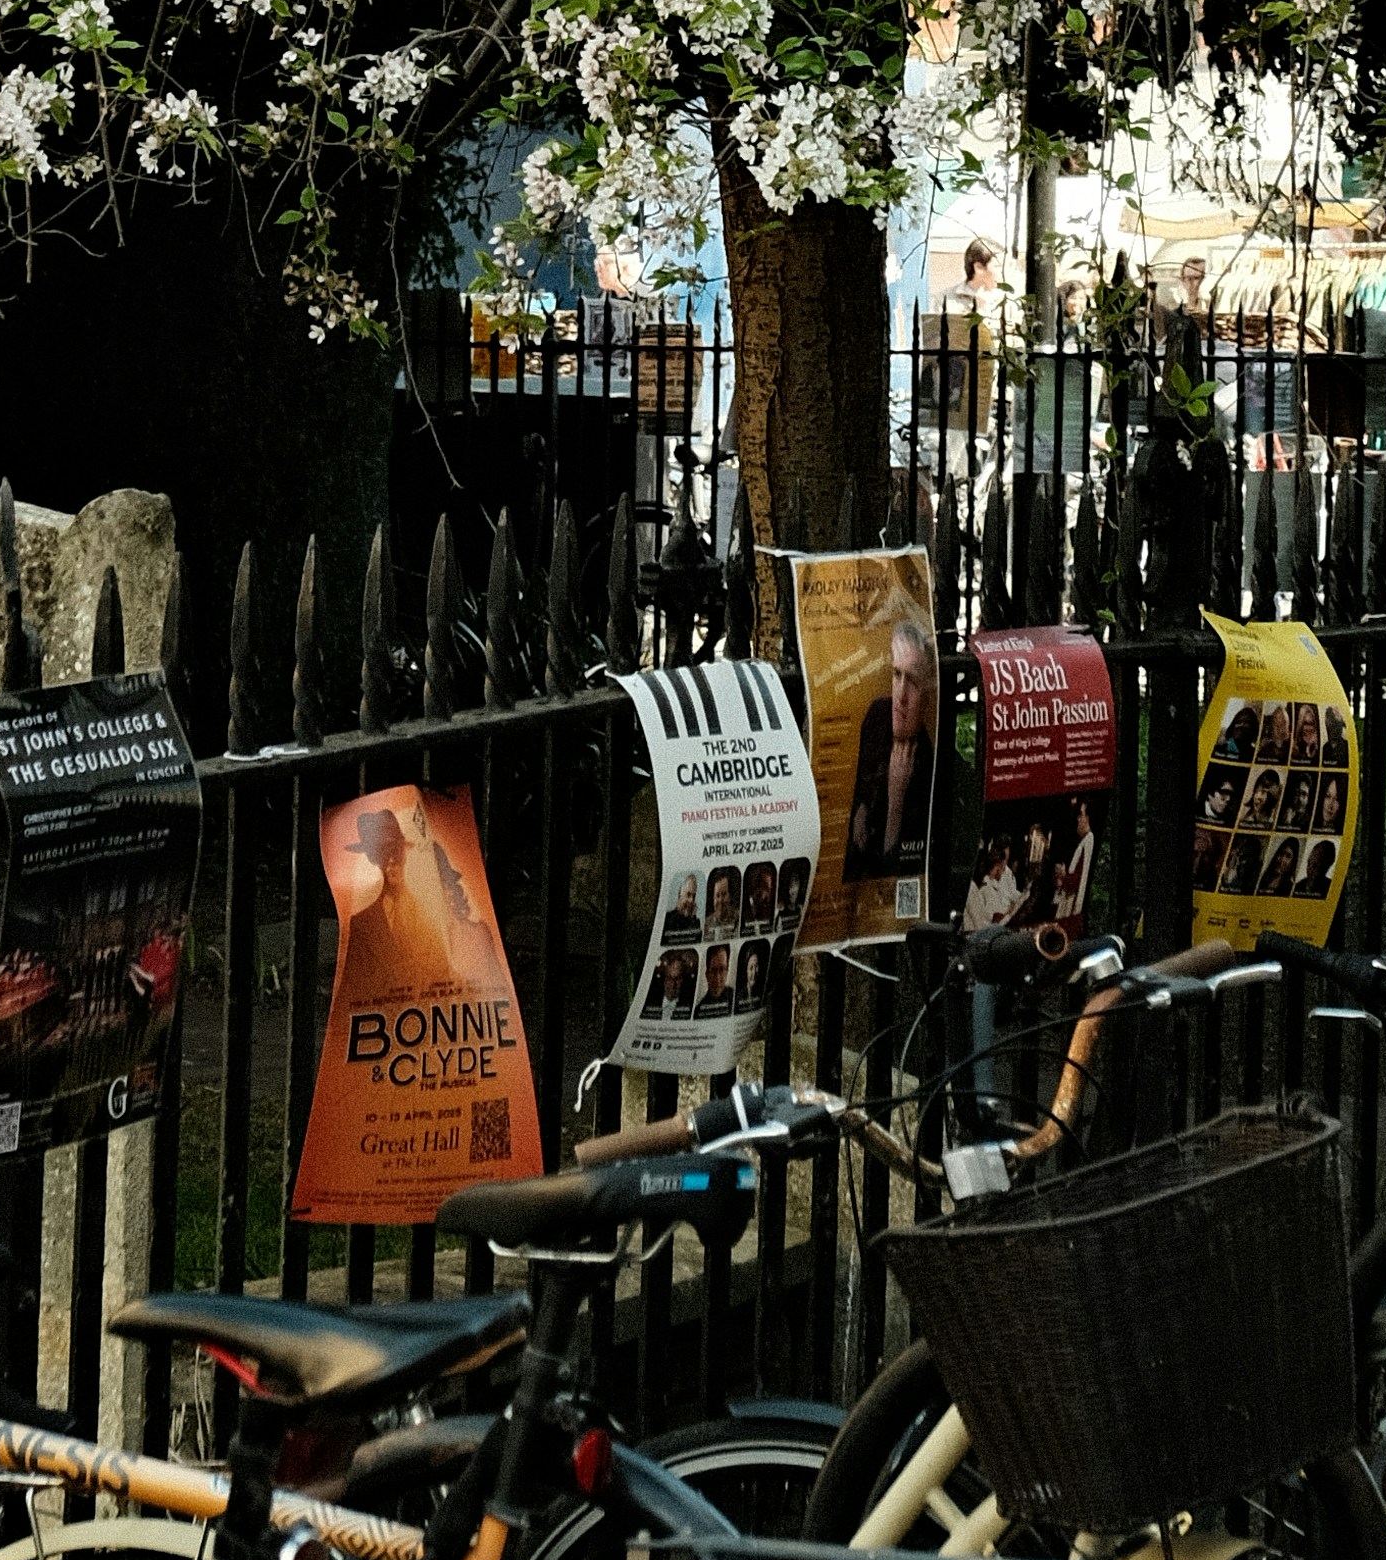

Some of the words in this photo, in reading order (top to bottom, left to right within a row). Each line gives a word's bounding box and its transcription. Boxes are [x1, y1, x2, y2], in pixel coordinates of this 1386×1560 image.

[989, 658, 1015, 697] JS
[1015, 653, 1069, 693] Bach
[12, 714, 44, 730] CHOIR
[45, 711, 58, 723] OF
[993, 703, 1010, 731] St
[1012, 698, 1050, 730] John
[1052, 693, 1109, 726] Passion
[22, 724, 84, 757] JOHN'S
[87, 713, 153, 741] COLLEGE
[155, 712, 167, 729] &
[702, 740, 728, 756] THE
[729, 737, 757, 754] 2ND
[7, 761, 47, 786] THE
[50, 744, 144, 779] GESUALDO
[147, 738, 179, 762] SIX
[676, 753, 793, 787] CAMBRIDGE
[704, 784, 773, 802] INTERNATIONAL
[681, 809, 709, 823] PIANO
[710, 805, 751, 821] FESTIVAL
[751, 803, 758, 816] &
[759, 799, 799, 815] ACADEMY
[702, 830, 738, 841] UNIVERSITY
[748, 824, 783, 836] CAMBRIDGE
[702, 843, 731, 859] APRIL
[761, 837, 785, 852] 2025
[346, 999, 518, 1064] BONNIE
[371, 1064, 385, 1084] &
[388, 1044, 498, 1088] CLYDE
[420, 1081, 438, 1092] THE
[440, 1078, 478, 1090] MUSICAL
[360, 1133, 416, 1155] Great
[422, 1126, 461, 1152] Hall
